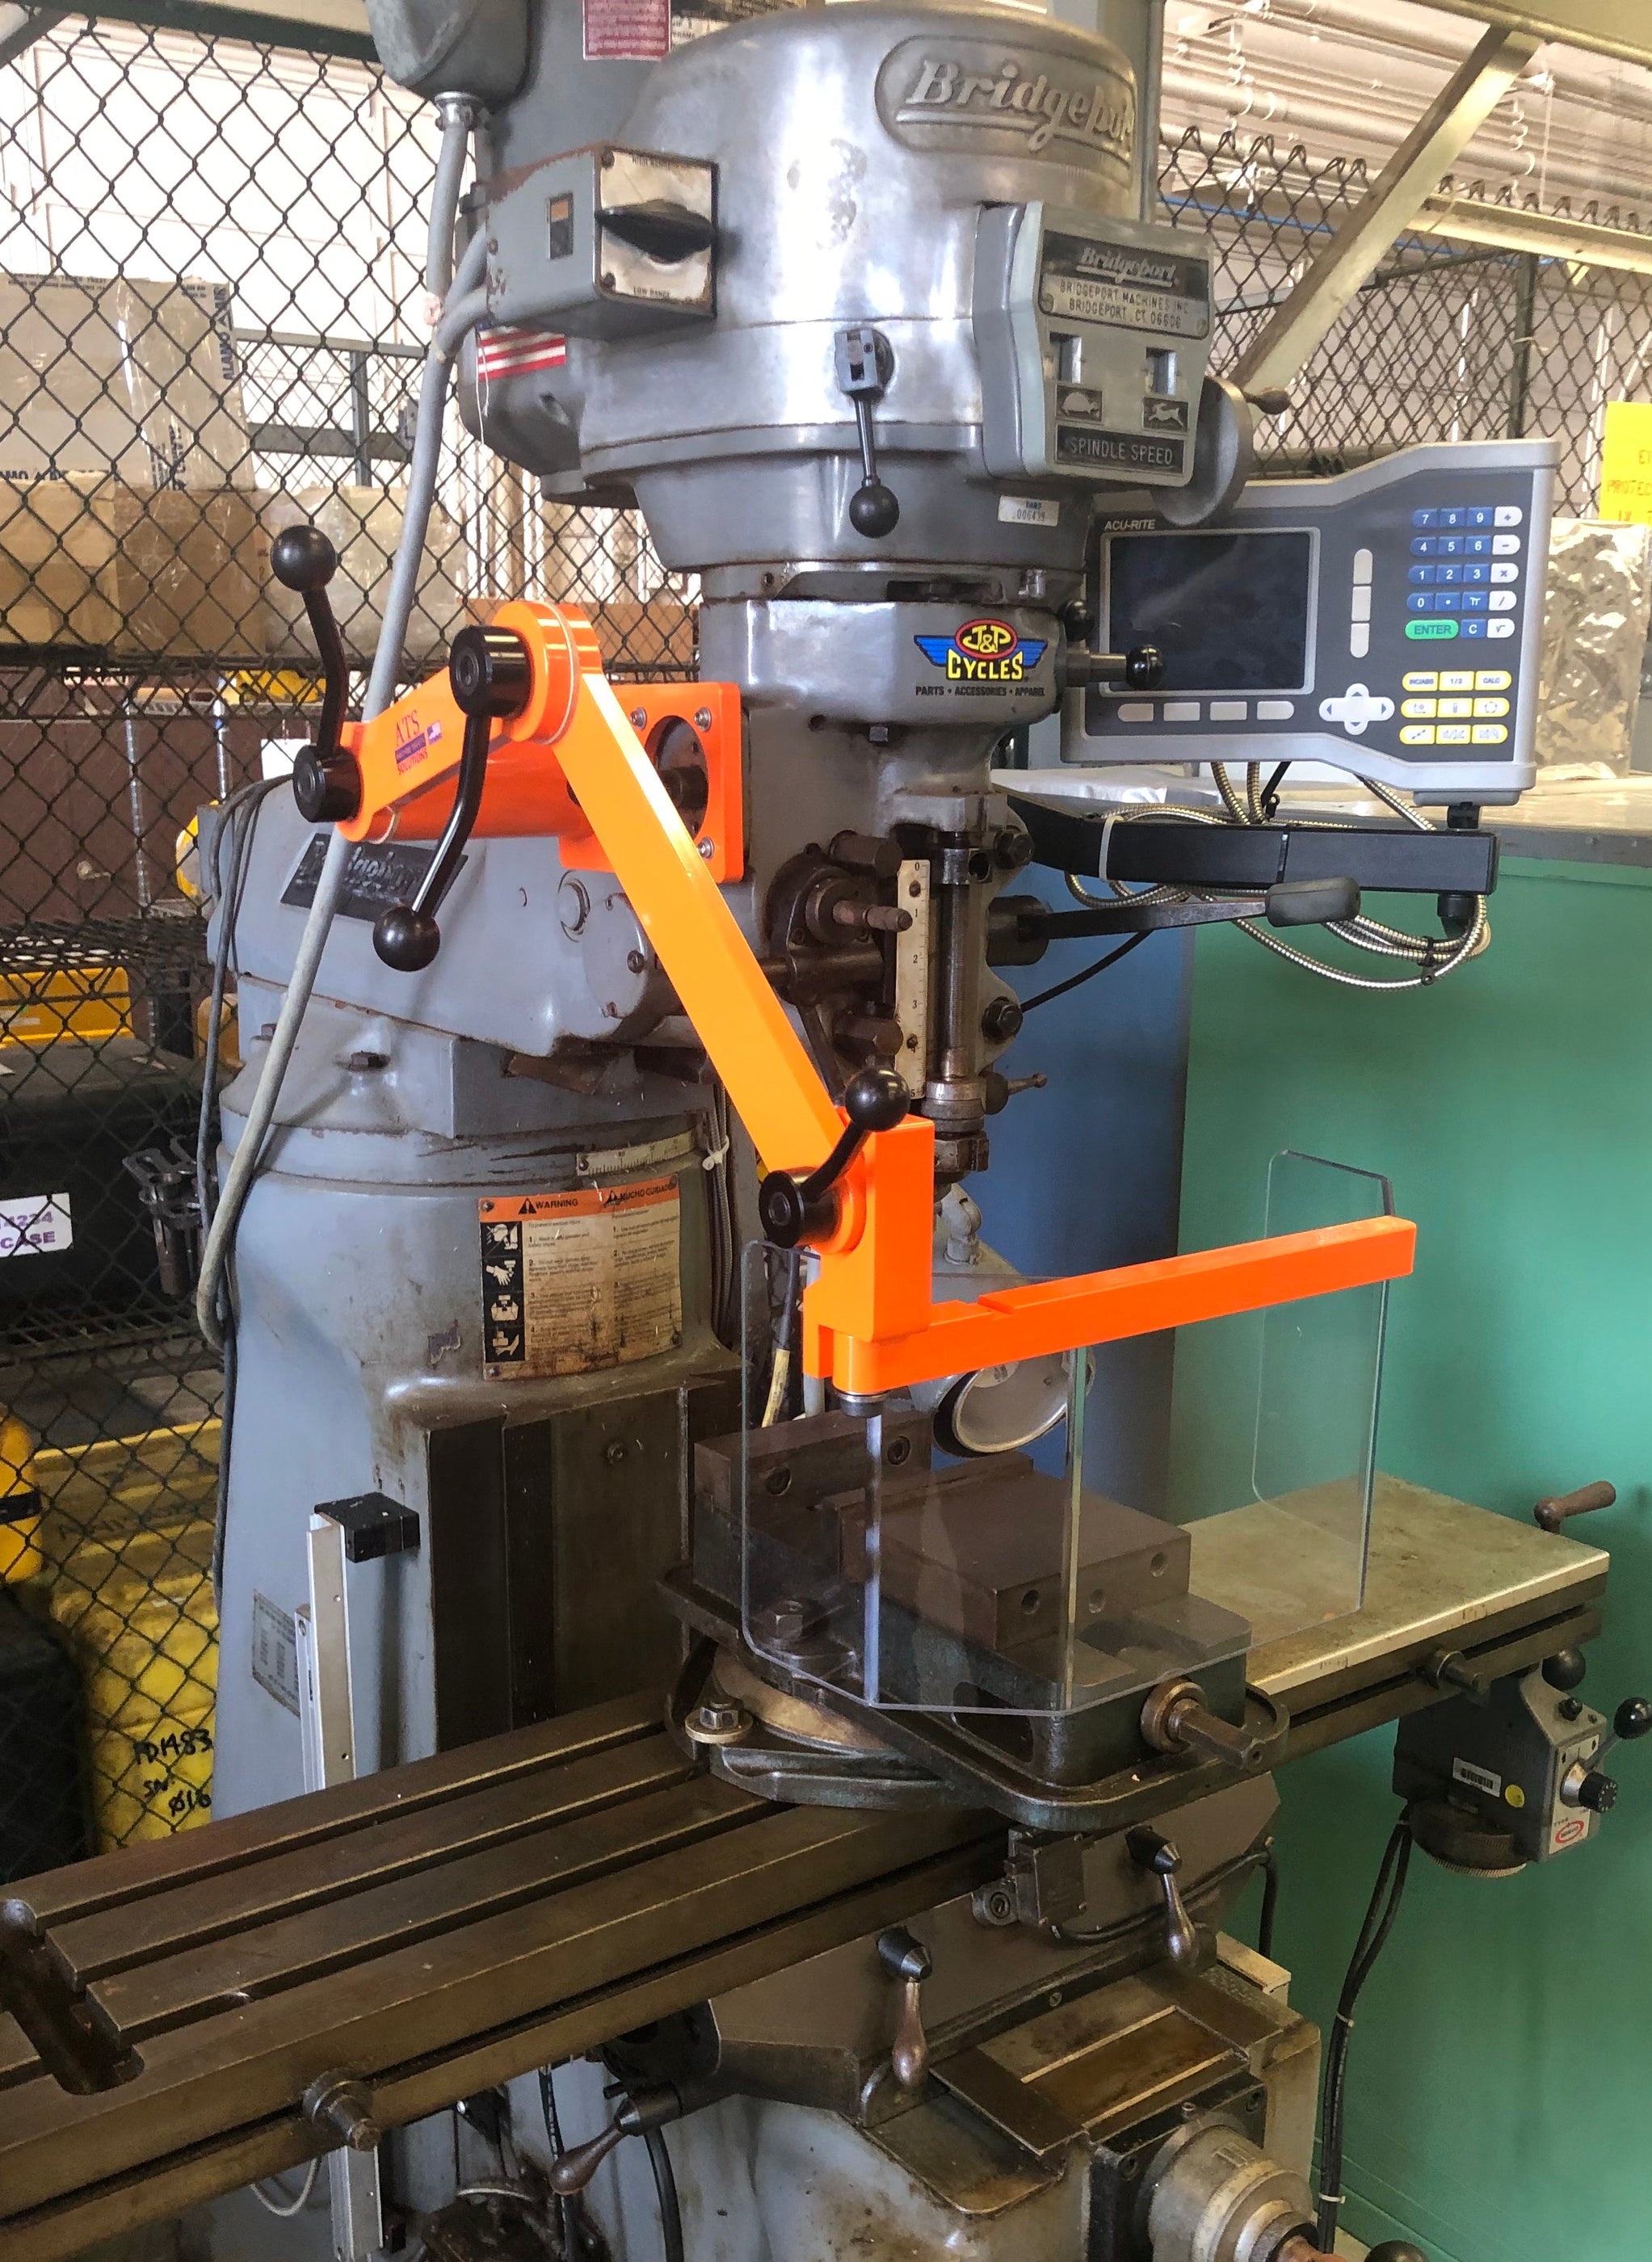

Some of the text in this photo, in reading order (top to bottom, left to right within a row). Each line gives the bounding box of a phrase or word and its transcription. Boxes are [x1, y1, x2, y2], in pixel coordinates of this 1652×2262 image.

[1078, 247, 1176, 283] Bridgeport
[1061, 280, 1119, 301] BRIDGEPORT
[1122, 292, 1170, 311] MACHINES
[1135, 309, 1145, 322] CT
[1070, 436, 1173, 465] SPINDLE SPEED
[1422, 512, 1484, 524] 7 8 9
[1104, 519, 1156, 531] ACU-RITE
[1419, 540, 1482, 553] 4 5 6
[1419, 569, 1481, 580] 1 2 3
[1417, 598, 1425, 608] 0
[1414, 624, 1478, 635] ENTER C
[962, 624, 1011, 654] J&P
[947, 648, 1024, 679] CYCLES
[915, 686, 1045, 696] PARTS ACCESSORIES APPAREL
[396, 709, 420, 746] ATS
[914, 862, 920, 872] 0
[914, 908, 918, 918] 1
[913, 954, 918, 964] 2
[912, 1000, 918, 1009] 3
[910, 1088, 916, 1097] 5
[536, 1198, 578, 1209] WARNING
[620, 1189, 645, 1200] MUCHO
